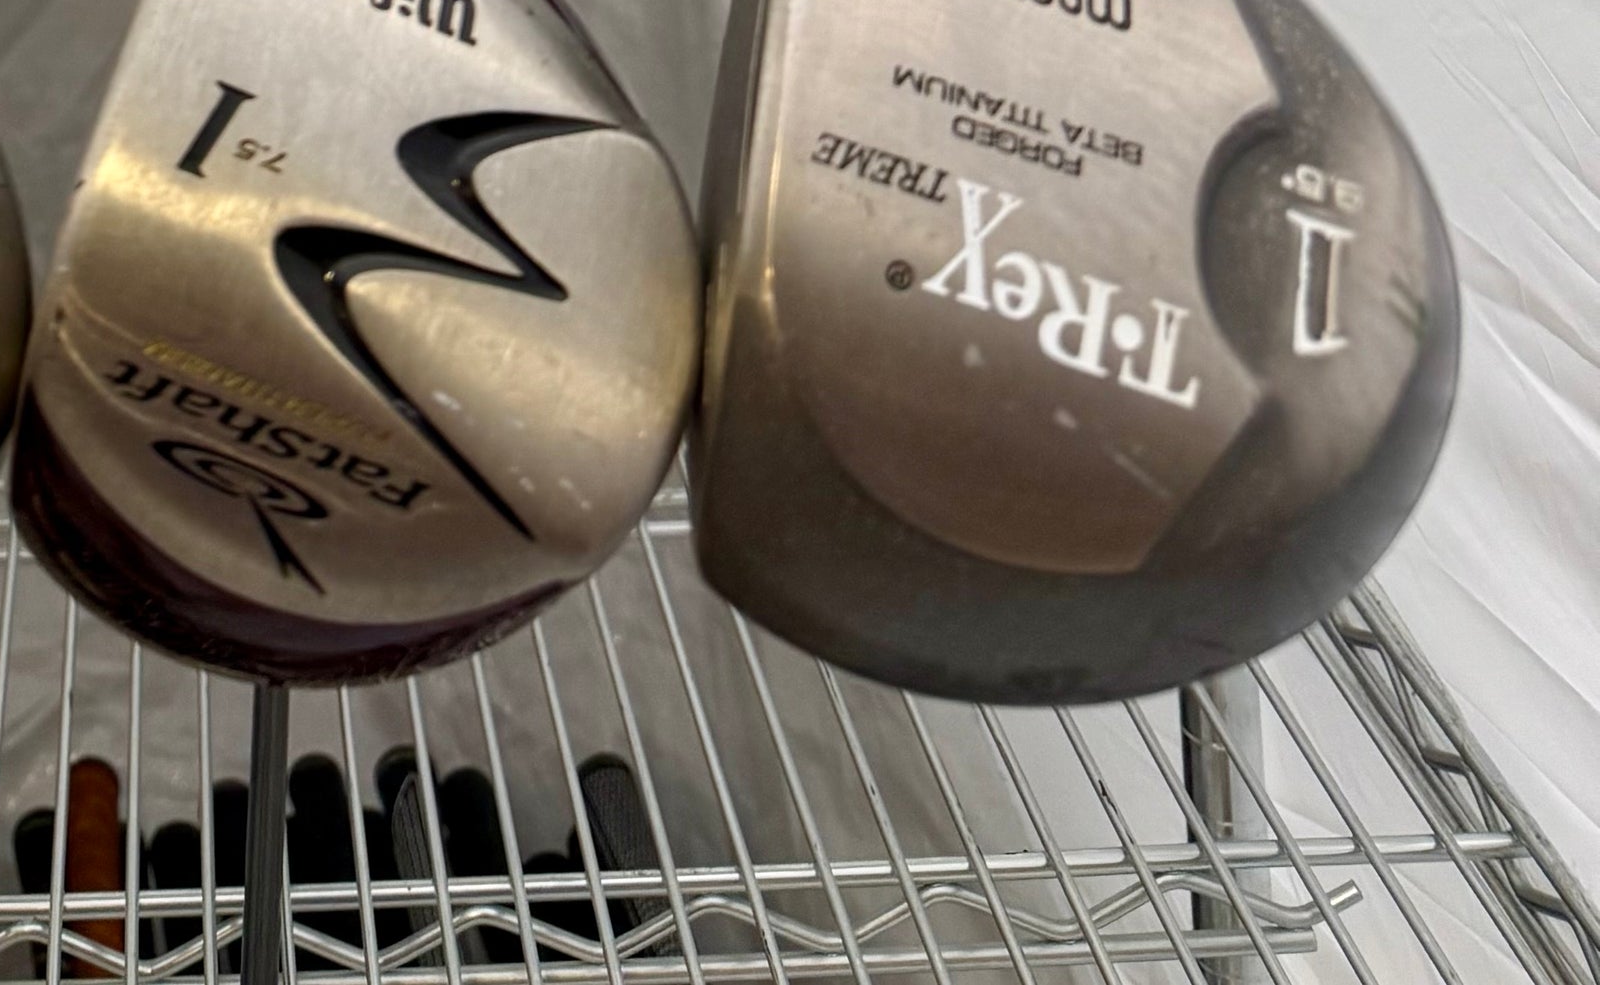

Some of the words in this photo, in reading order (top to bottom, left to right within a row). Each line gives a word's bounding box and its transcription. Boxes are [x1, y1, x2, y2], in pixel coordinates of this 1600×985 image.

[177, 79, 257, 179] 1
[892, 64, 1052, 134] TITANIUM
[232, 137, 288, 174] 7.5
[810, 131, 950, 204] TREME
[951, 114, 1084, 177] FORGED
[1060, 118, 1145, 166] BETA
[1284, 208, 1357, 359] 1
[106, 359, 432, 511] FatShaft
